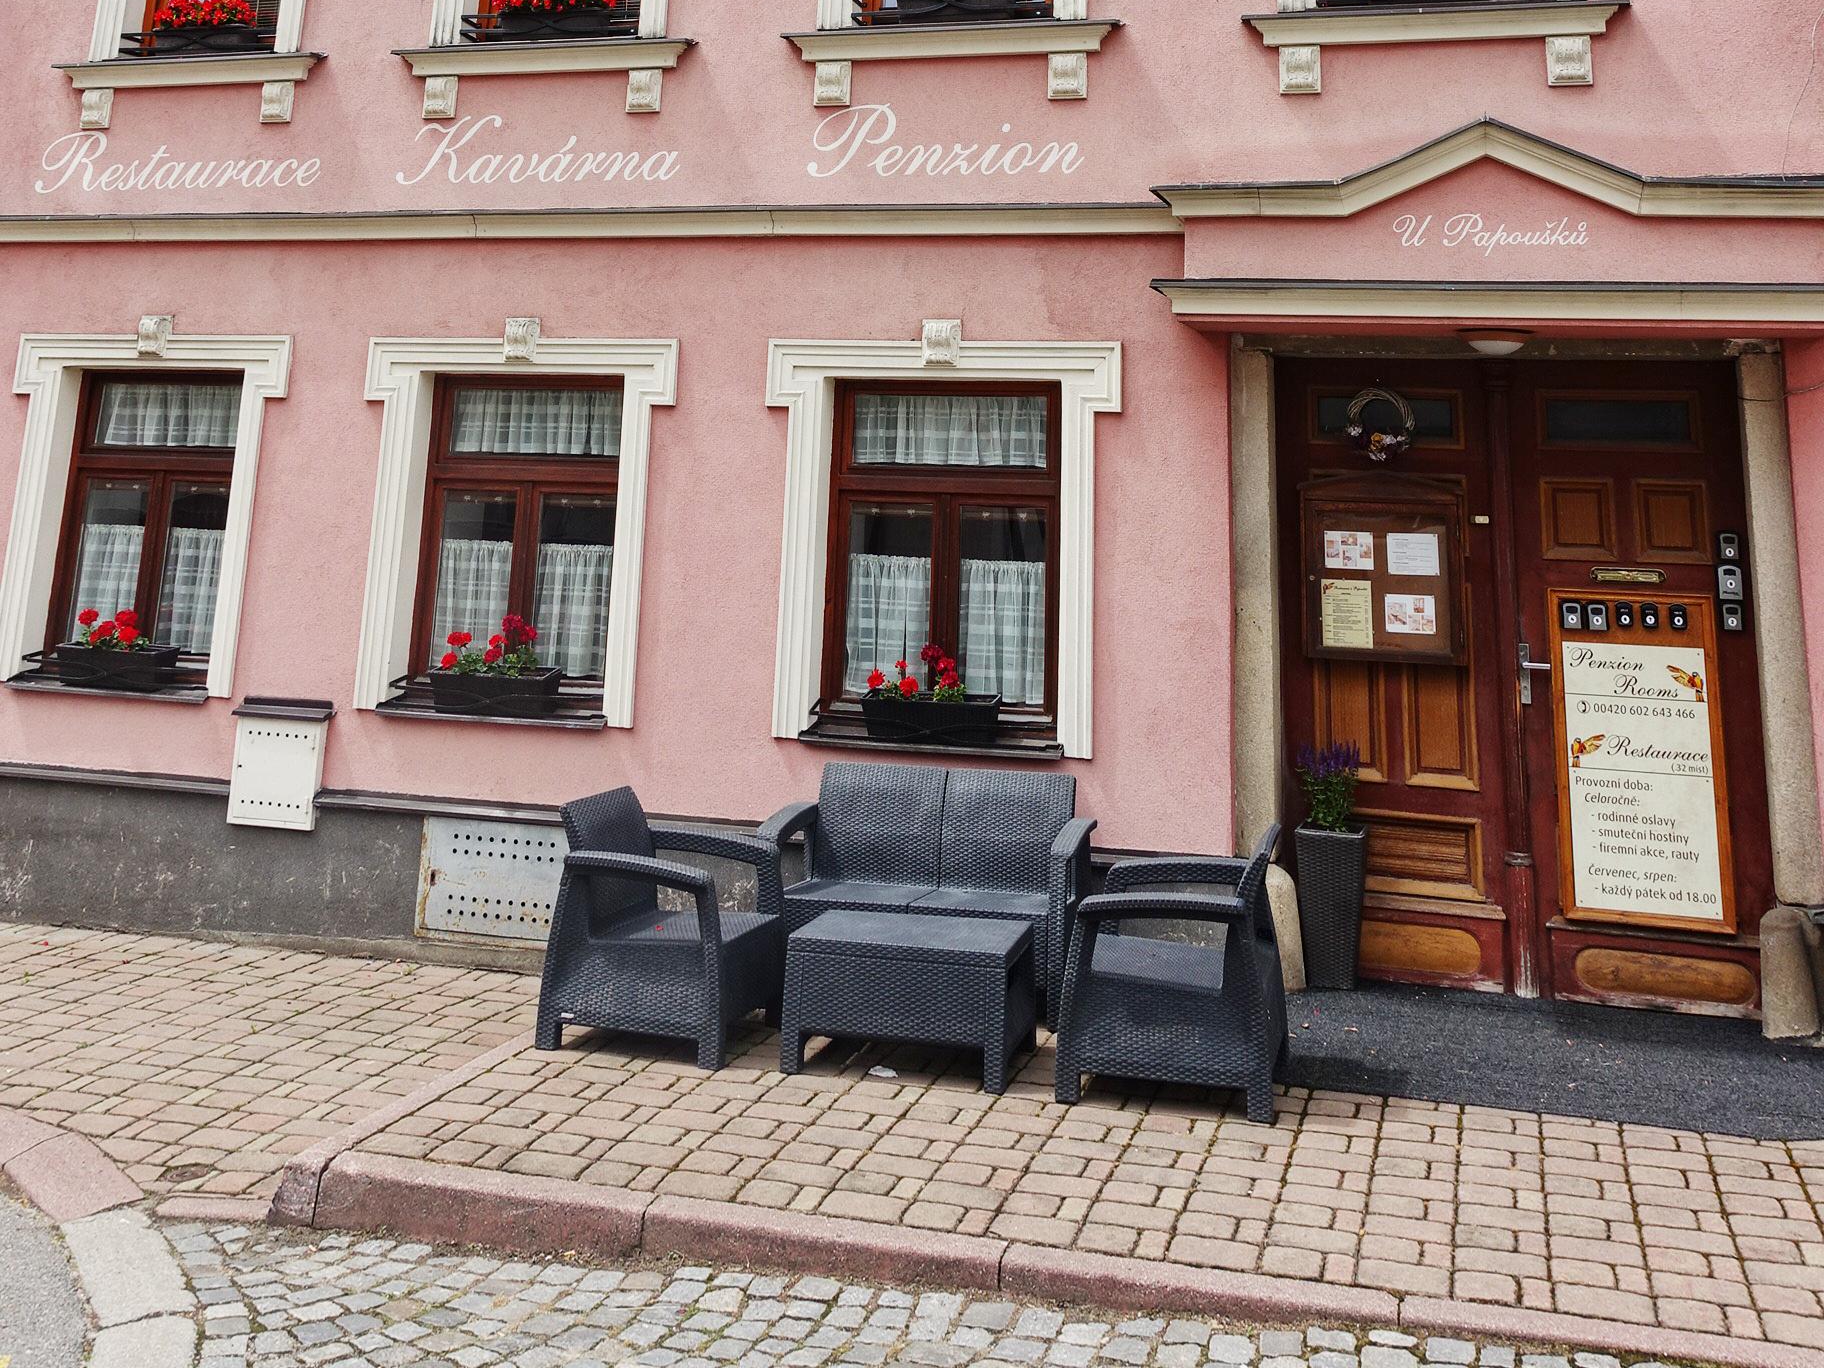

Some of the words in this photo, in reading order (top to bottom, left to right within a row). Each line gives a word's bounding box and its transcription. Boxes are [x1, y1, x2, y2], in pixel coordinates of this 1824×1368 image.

[396, 115, 681, 185] Kavárna
[806, 103, 1085, 177] Penzion
[35, 131, 321, 194] Restaurace
[1392, 214, 1432, 247] U
[1443, 213, 1589, 256] Papoušků
[1569, 646, 1644, 671] Penzion
[1613, 674, 1679, 699] Rooms
[1593, 702, 1627, 715] 00420
[1629, 705, 1649, 716] 602
[1652, 707, 1672, 718] 643
[1675, 709, 1696, 719] 466
[1605, 734, 1709, 762] Restaurace
[1575, 775, 1621, 789] Provozní
[1623, 778, 1654, 792] doba:
[1597, 811, 1639, 824] rodinné
[1641, 814, 1676, 829] oslavy
[1598, 828, 1647, 840] smuteční
[1649, 831, 1689, 846] hostiny
[1599, 841, 1638, 855] firemní
[1640, 845, 1669, 860] akce,
[1671, 849, 1700, 863] rauty
[1588, 863, 1640, 880] Červenec,
[1643, 871, 1678, 883] srpen:
[1601, 883, 1633, 899] každý
[1635, 887, 1667, 900] pátek
[1669, 889, 1683, 901] od
[1686, 892, 1717, 905] 18.00
